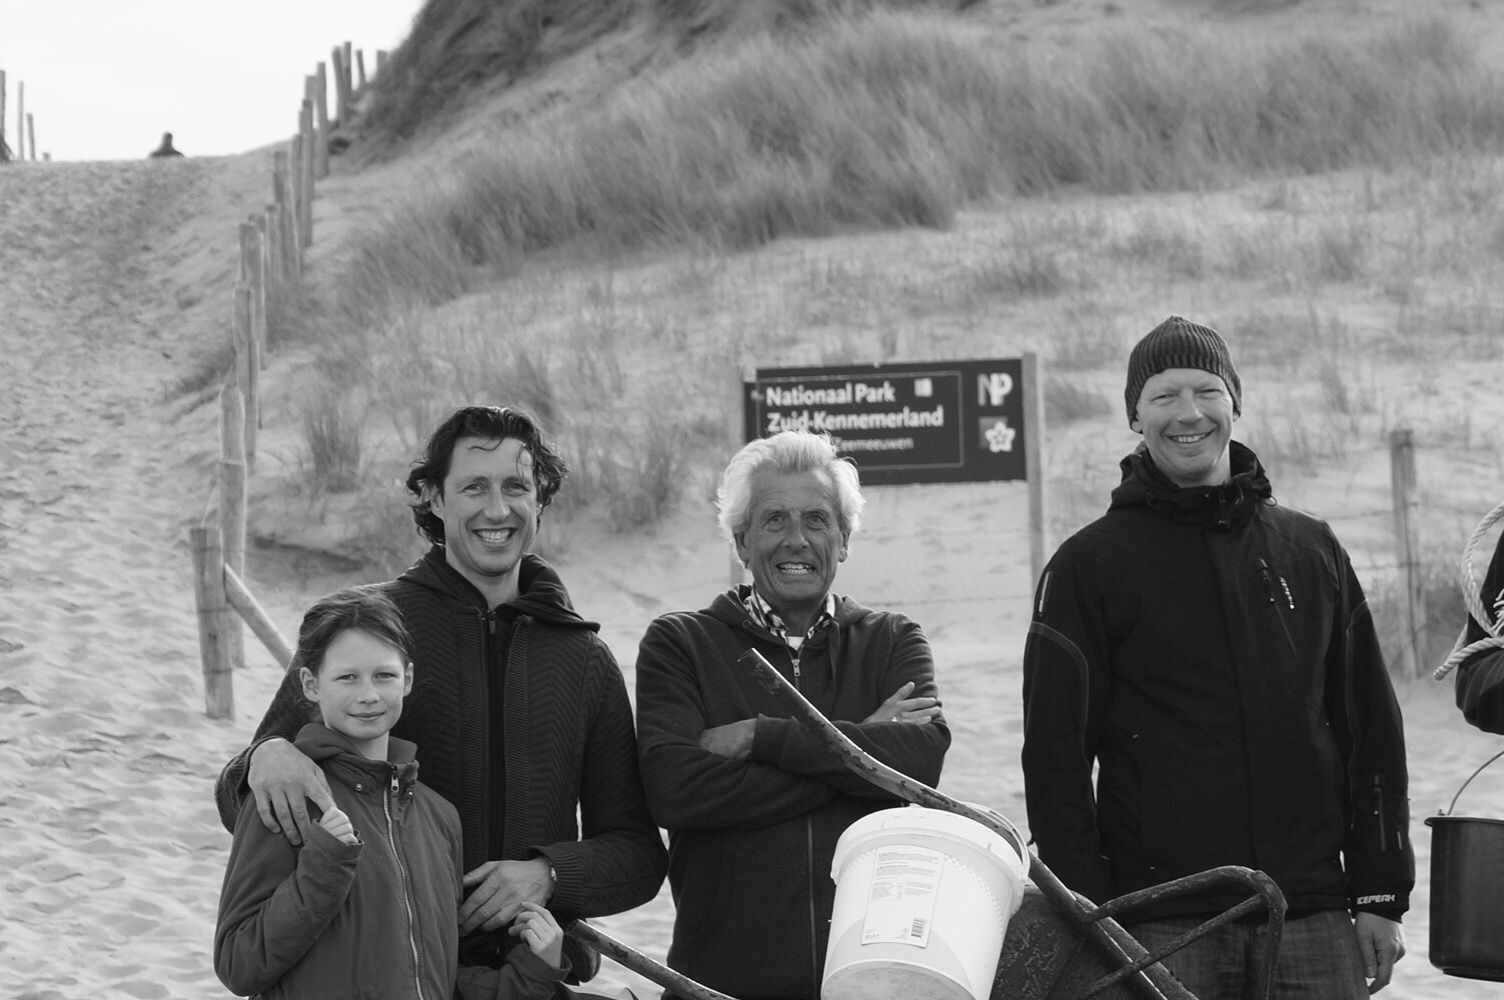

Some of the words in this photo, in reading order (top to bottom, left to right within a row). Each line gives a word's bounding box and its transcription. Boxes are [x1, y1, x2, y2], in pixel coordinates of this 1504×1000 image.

[766, 382, 852, 406] Nationaal
[855, 381, 896, 403] Park
[766, 404, 944, 432] Zuid-Kennemerland
[1356, 893, 1395, 905] ICEPEAK
